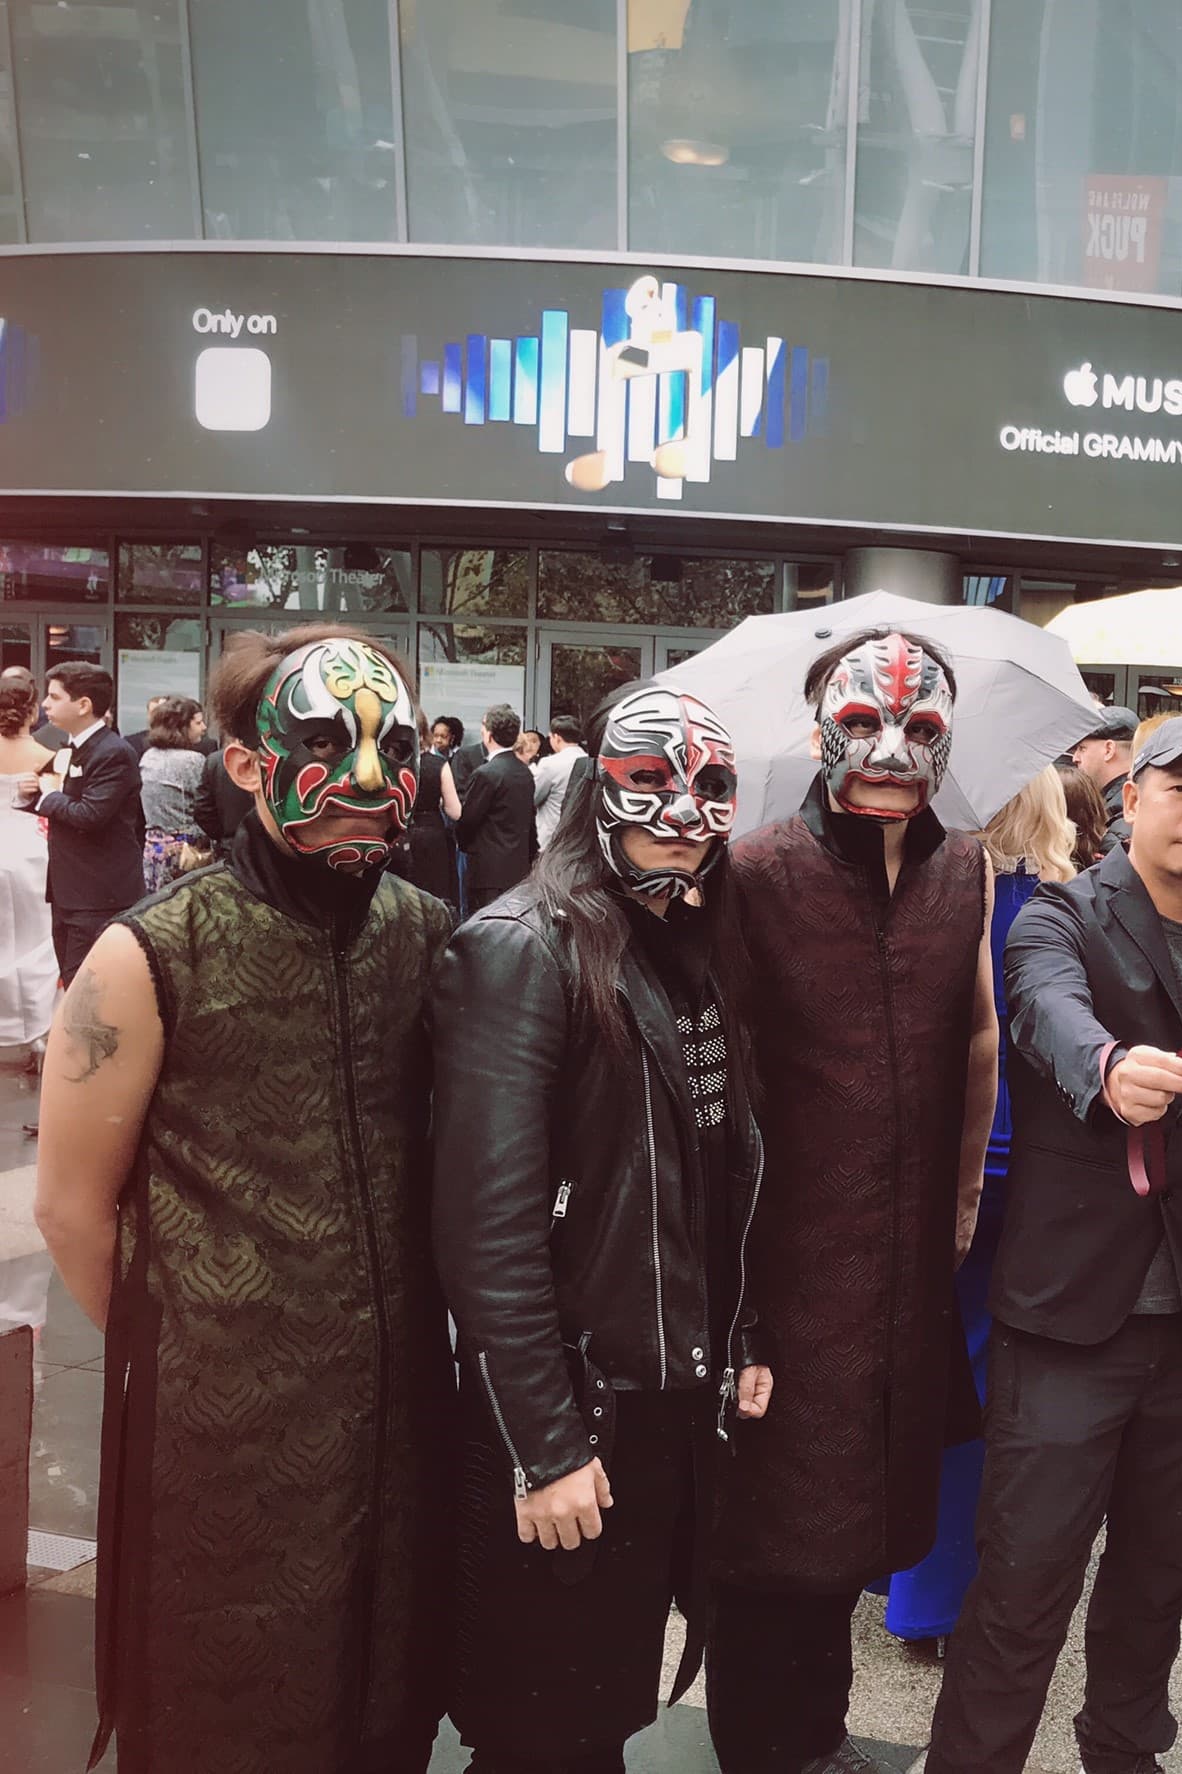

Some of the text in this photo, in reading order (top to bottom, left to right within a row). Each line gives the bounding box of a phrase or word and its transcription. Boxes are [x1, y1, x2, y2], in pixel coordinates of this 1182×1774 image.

[192, 308, 277, 338] Only on
[1000, 426, 1079, 455] Official
[330, 568, 386, 585] Theater
